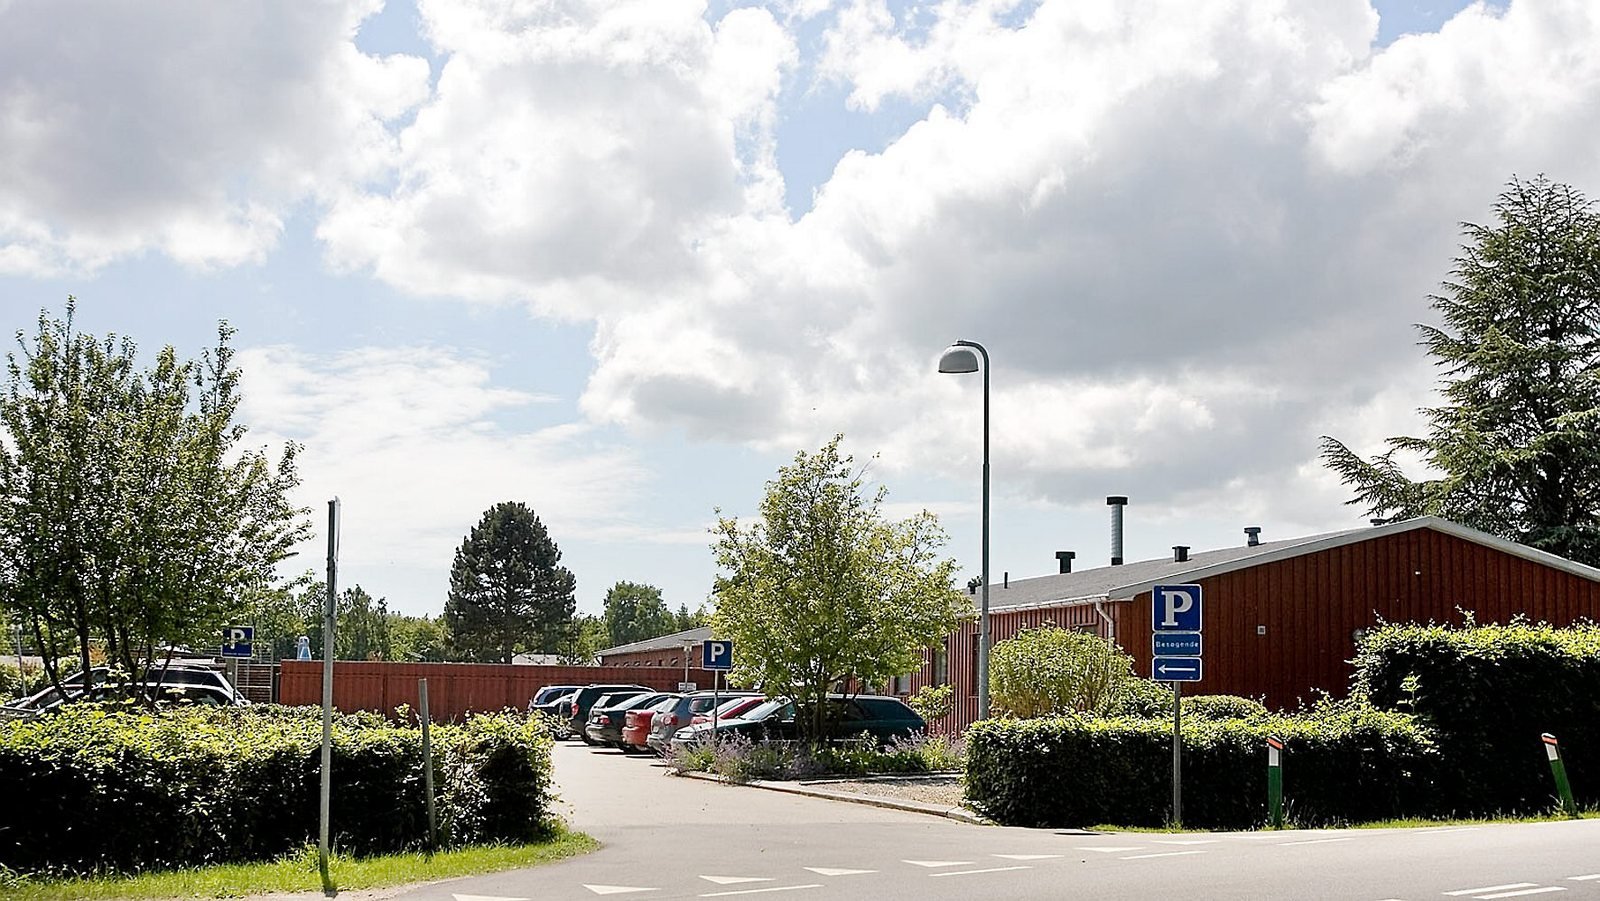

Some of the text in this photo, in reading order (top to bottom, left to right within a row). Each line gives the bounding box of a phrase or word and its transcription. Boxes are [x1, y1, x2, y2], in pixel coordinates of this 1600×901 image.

[1161, 591, 1193, 626] P
[230, 629, 245, 649] P
[711, 643, 725, 662] P
